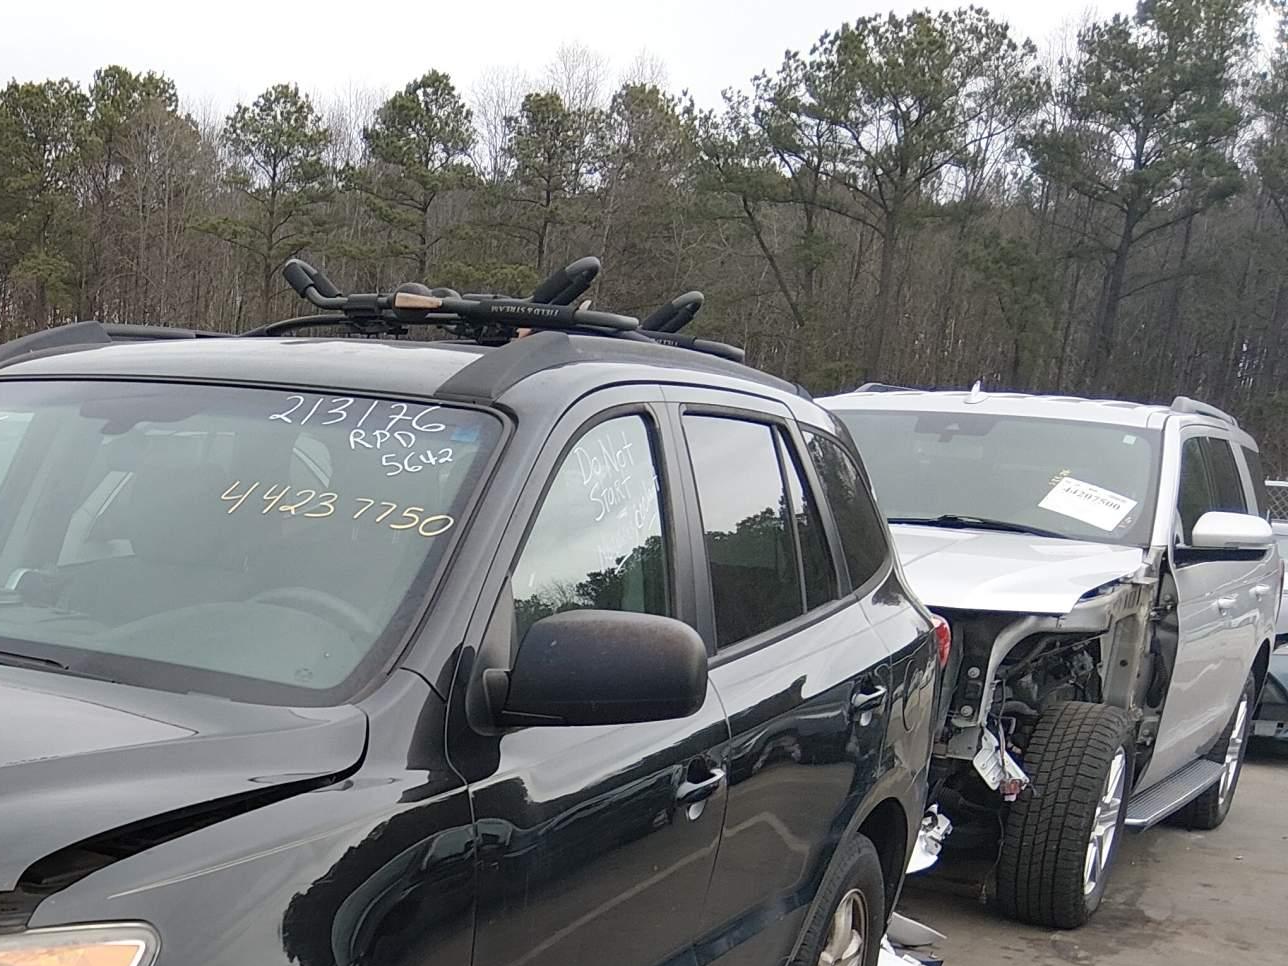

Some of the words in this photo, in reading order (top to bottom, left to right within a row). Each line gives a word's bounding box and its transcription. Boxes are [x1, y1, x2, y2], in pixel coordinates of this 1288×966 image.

[268, 395, 446, 432] 213176
[349, 429, 416, 449] RPD
[381, 448, 453, 476] 5642
